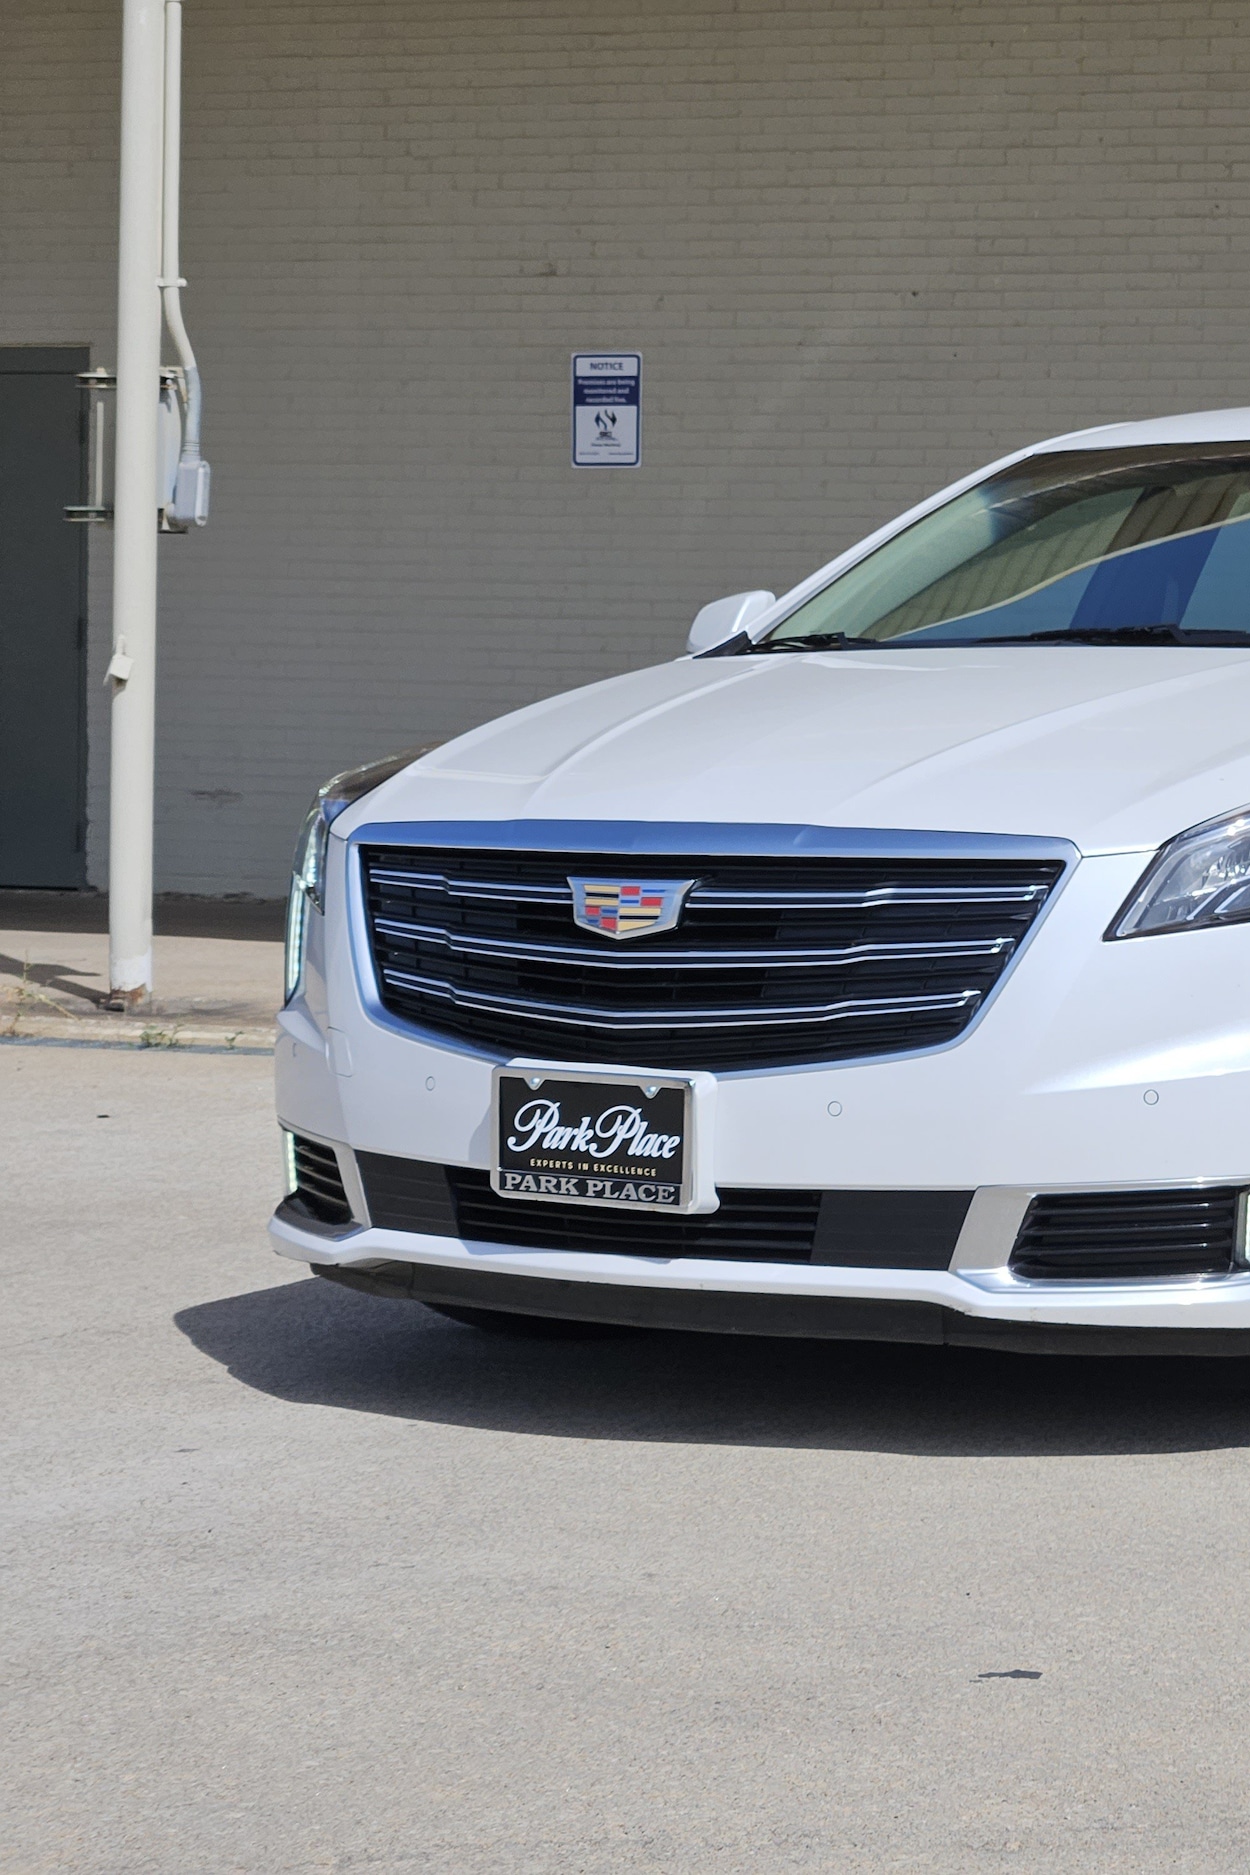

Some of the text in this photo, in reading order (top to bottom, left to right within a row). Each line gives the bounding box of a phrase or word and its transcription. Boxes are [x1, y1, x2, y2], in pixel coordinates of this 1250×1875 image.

[590, 362, 624, 371] NOTICE
[507, 1099, 681, 1159] Park Place
[529, 1158, 657, 1177] EXPERTS IN EXCELLENCE
[504, 1173, 676, 1204] PARK PLACE
